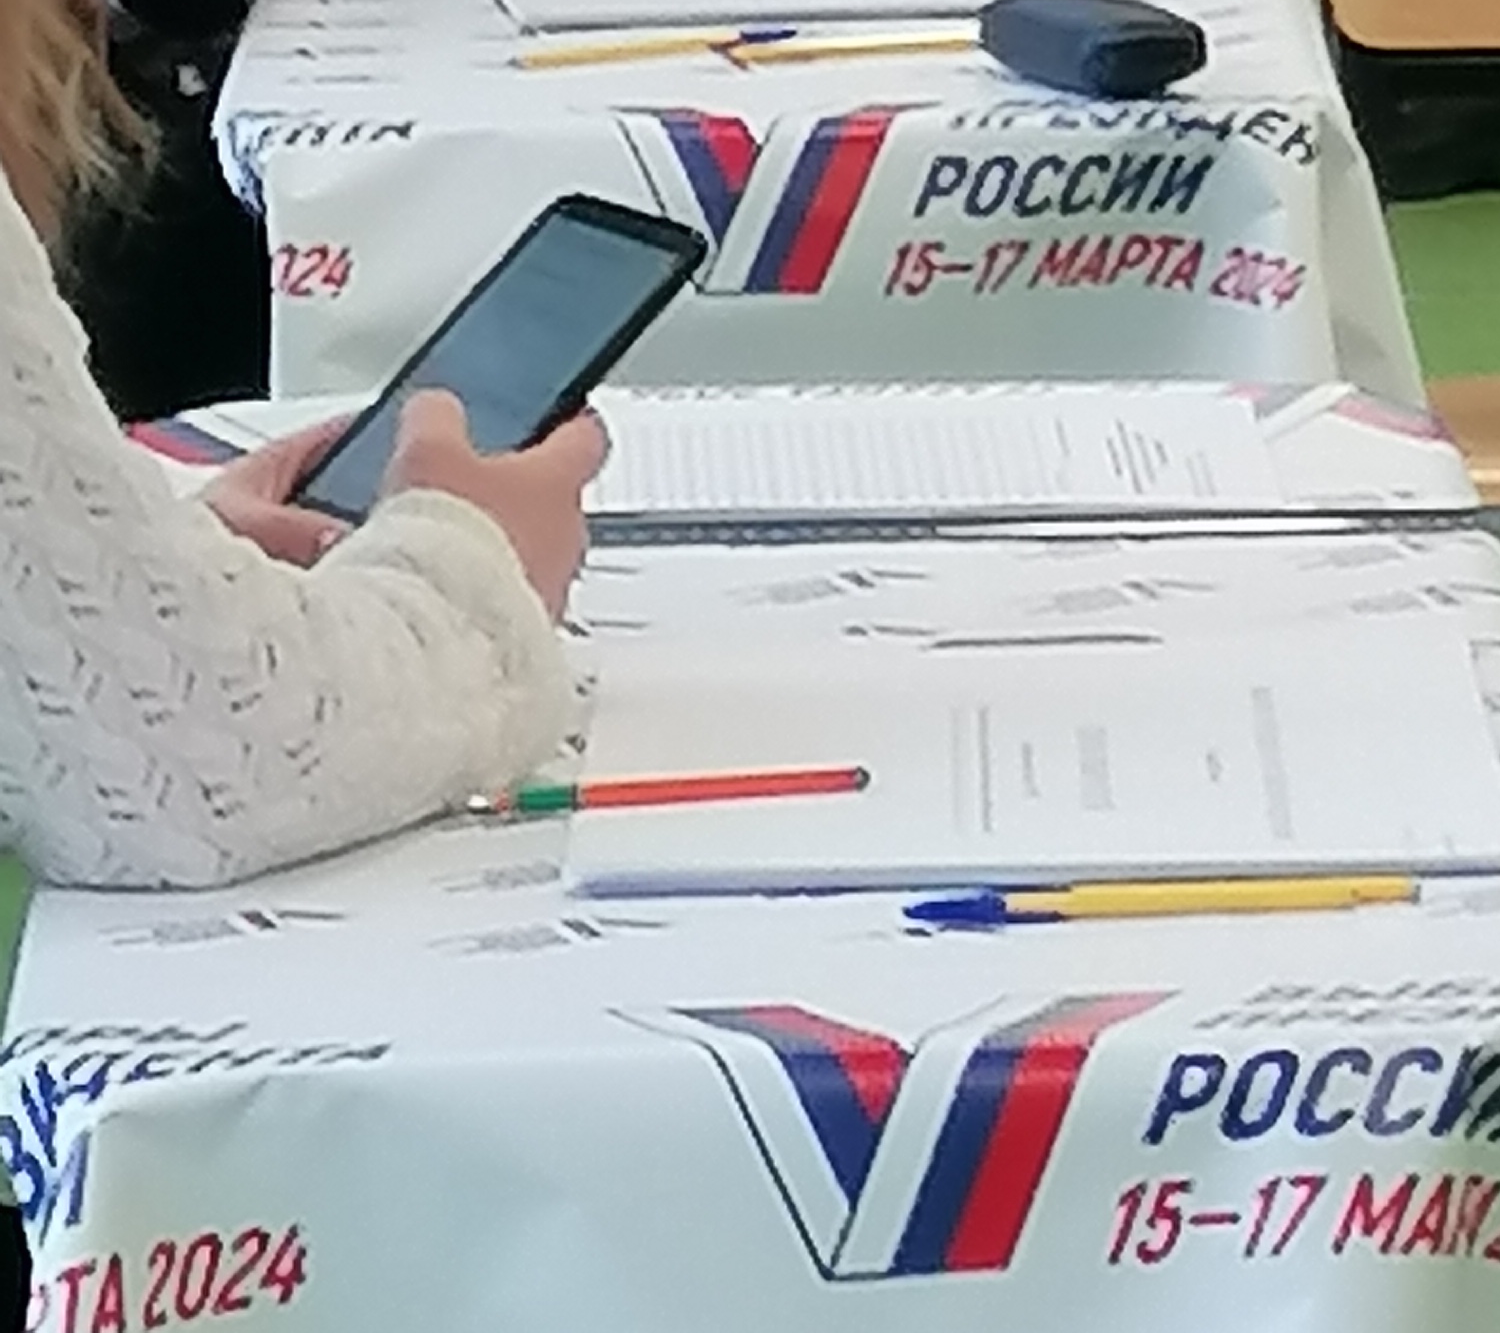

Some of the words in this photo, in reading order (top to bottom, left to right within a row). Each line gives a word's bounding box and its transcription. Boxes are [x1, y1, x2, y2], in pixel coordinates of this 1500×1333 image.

[913, 154, 1214, 218] РОССИИ
[1027, 233, 1206, 291] МАРТА
[1208, 246, 1306, 311] 2024
[143, 1223, 308, 1329] 2024
